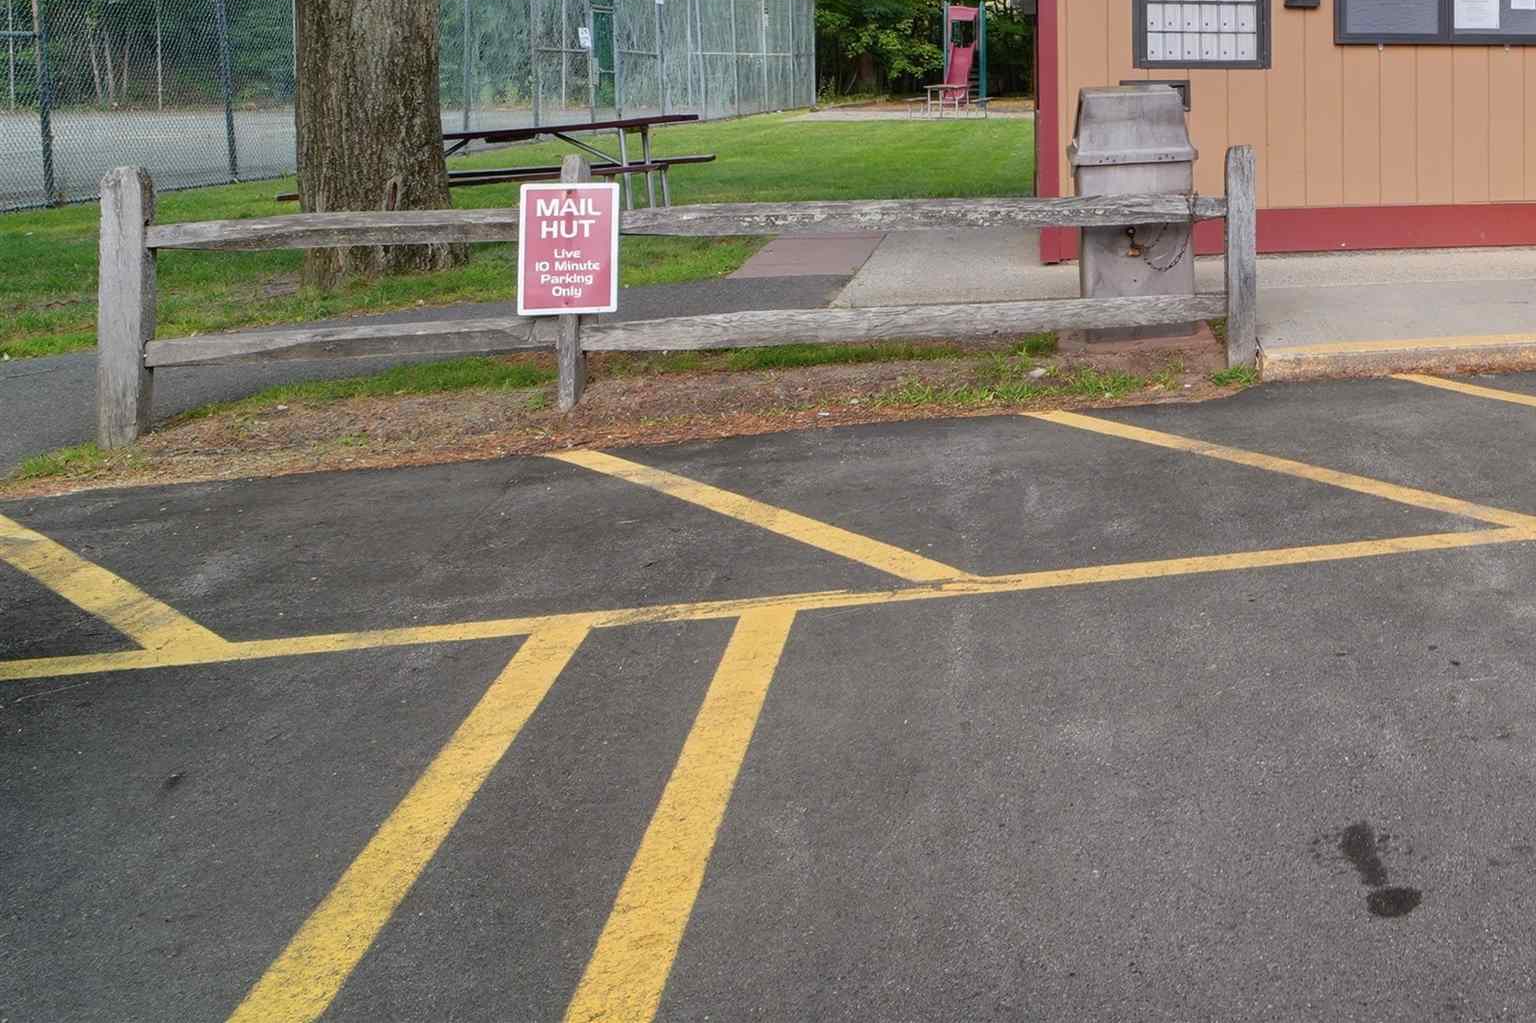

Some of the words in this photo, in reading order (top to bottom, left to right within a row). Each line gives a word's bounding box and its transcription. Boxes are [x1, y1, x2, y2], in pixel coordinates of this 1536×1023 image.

[536, 198, 602, 217] MAIL
[541, 219, 596, 239] HUT
[553, 248, 581, 258] Live
[536, 262, 550, 272] 10
[554, 260, 600, 271] Minute
[540, 273, 593, 285] Parking
[552, 286, 582, 298] Only
